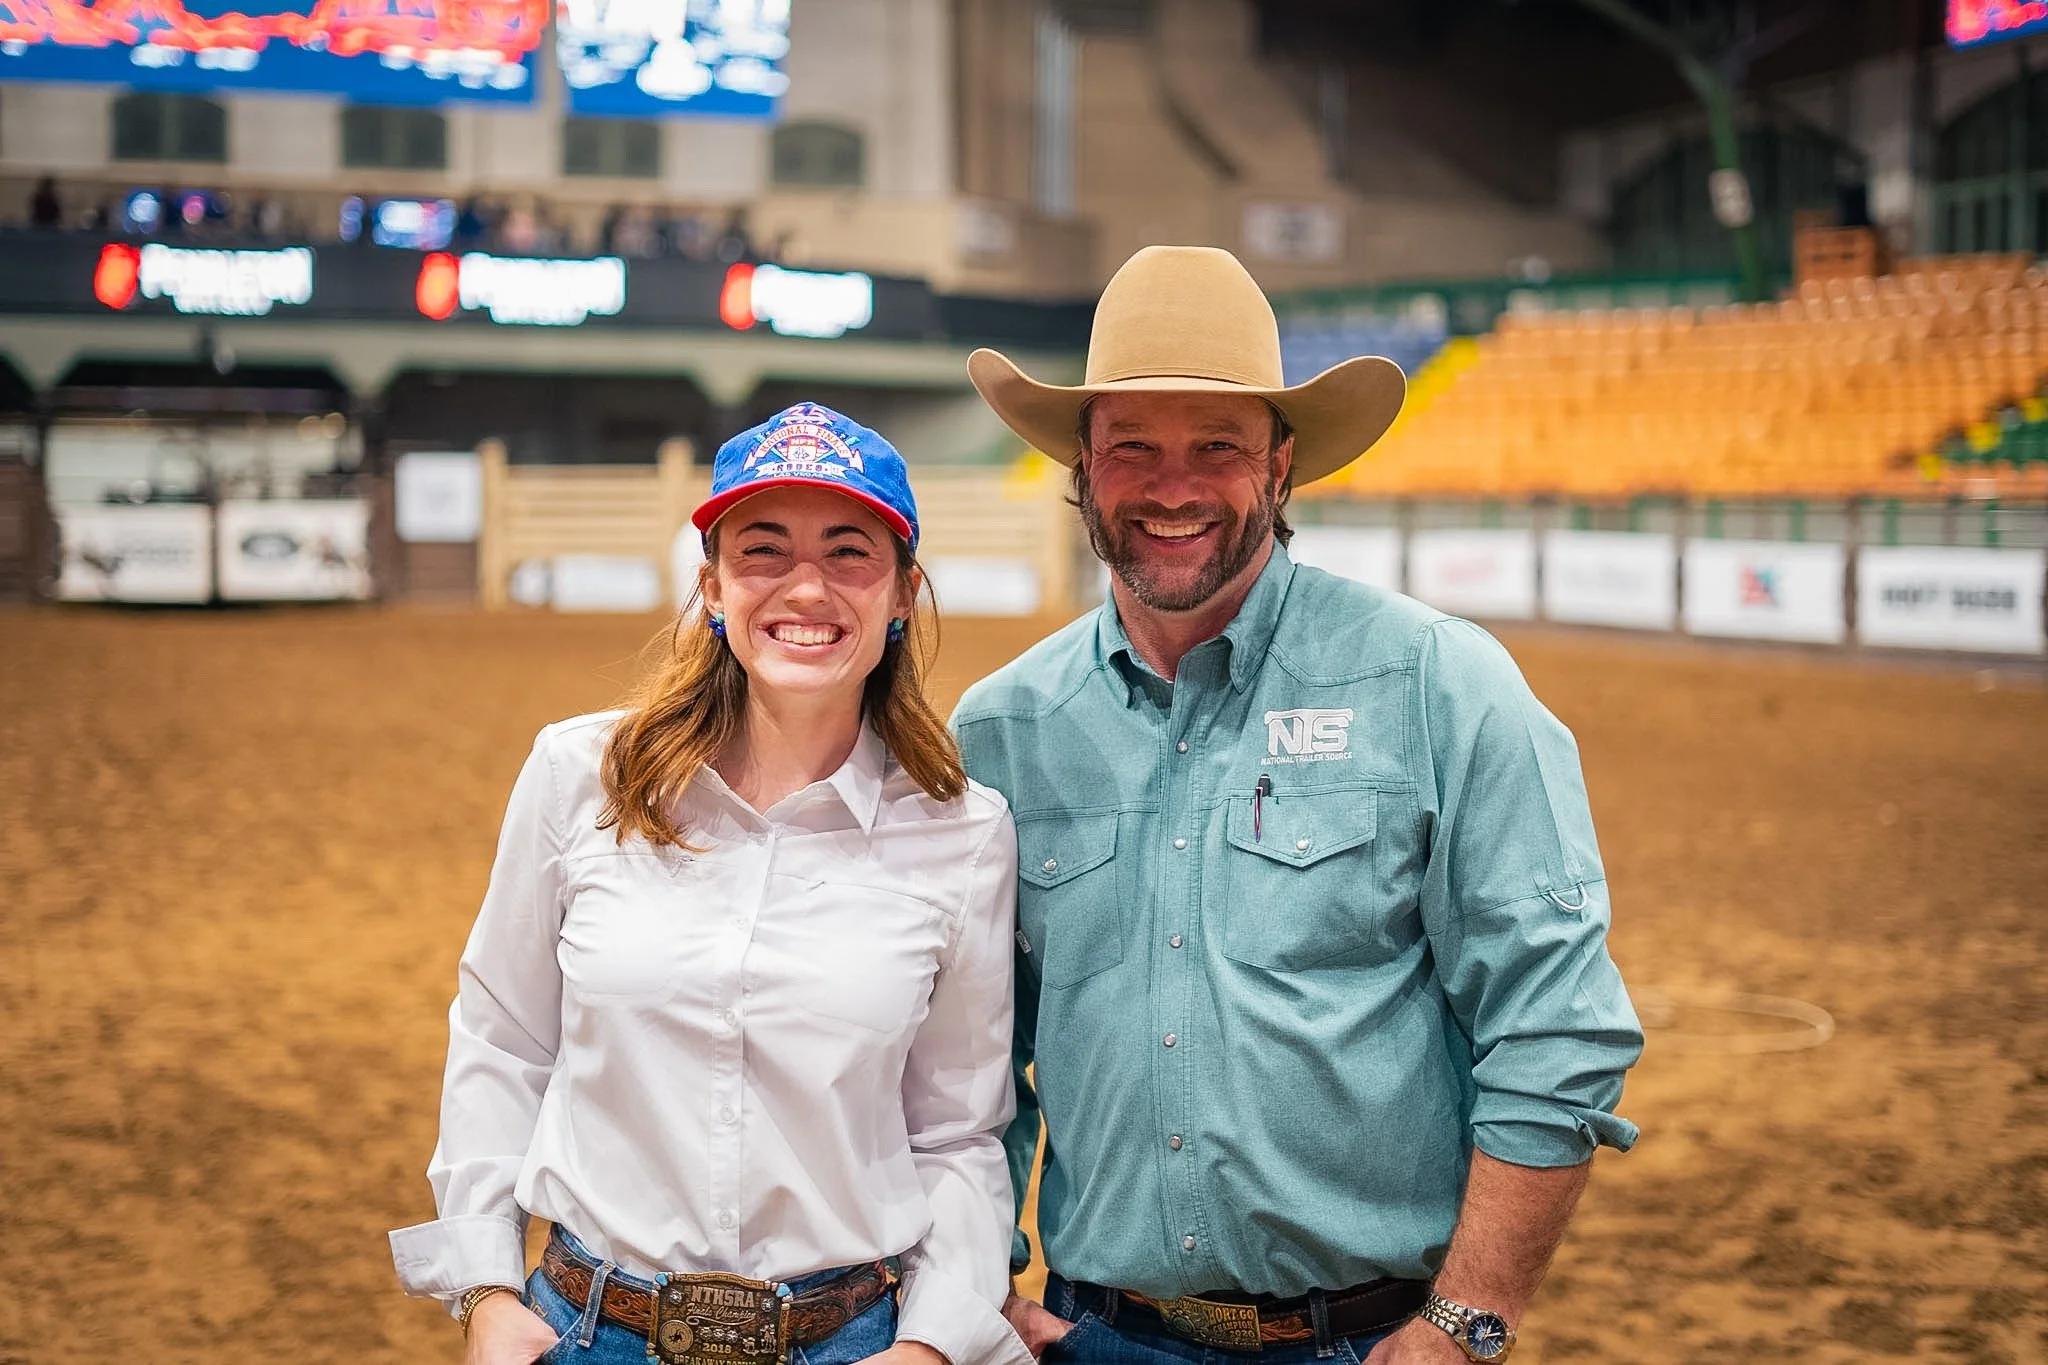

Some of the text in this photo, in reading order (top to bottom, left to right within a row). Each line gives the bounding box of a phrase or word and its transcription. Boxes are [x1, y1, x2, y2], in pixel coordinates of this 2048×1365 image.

[760, 425, 809, 452] NATIONAL
[776, 463, 823, 472] RODEO
[1264, 708, 1354, 756] NTS
[1260, 751, 1353, 766] NATIONAL TRAILER SOURCE
[691, 1285, 755, 1308] NTHSRA
[702, 1342, 732, 1354] 2018
